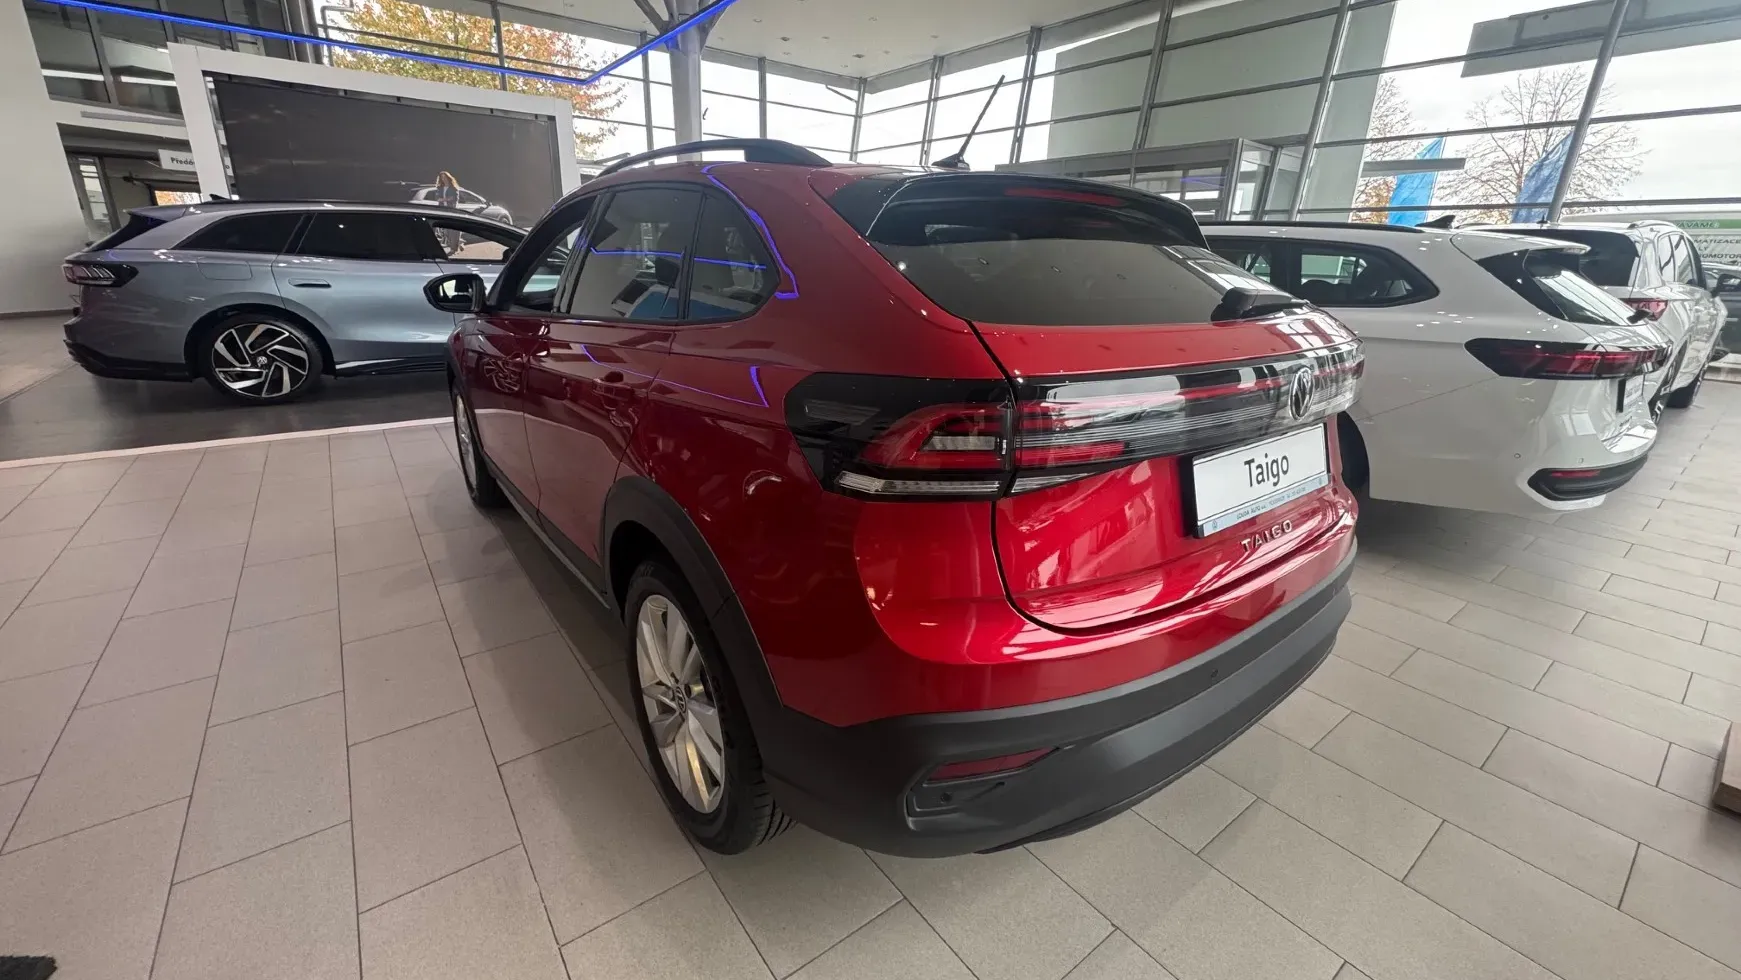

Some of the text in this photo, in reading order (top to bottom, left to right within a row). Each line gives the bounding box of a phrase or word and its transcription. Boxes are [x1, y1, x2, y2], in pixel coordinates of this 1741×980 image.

[170, 156, 196, 166] Předá
[1244, 453, 1289, 487] Taigo
[1241, 519, 1292, 552] TAIGO
